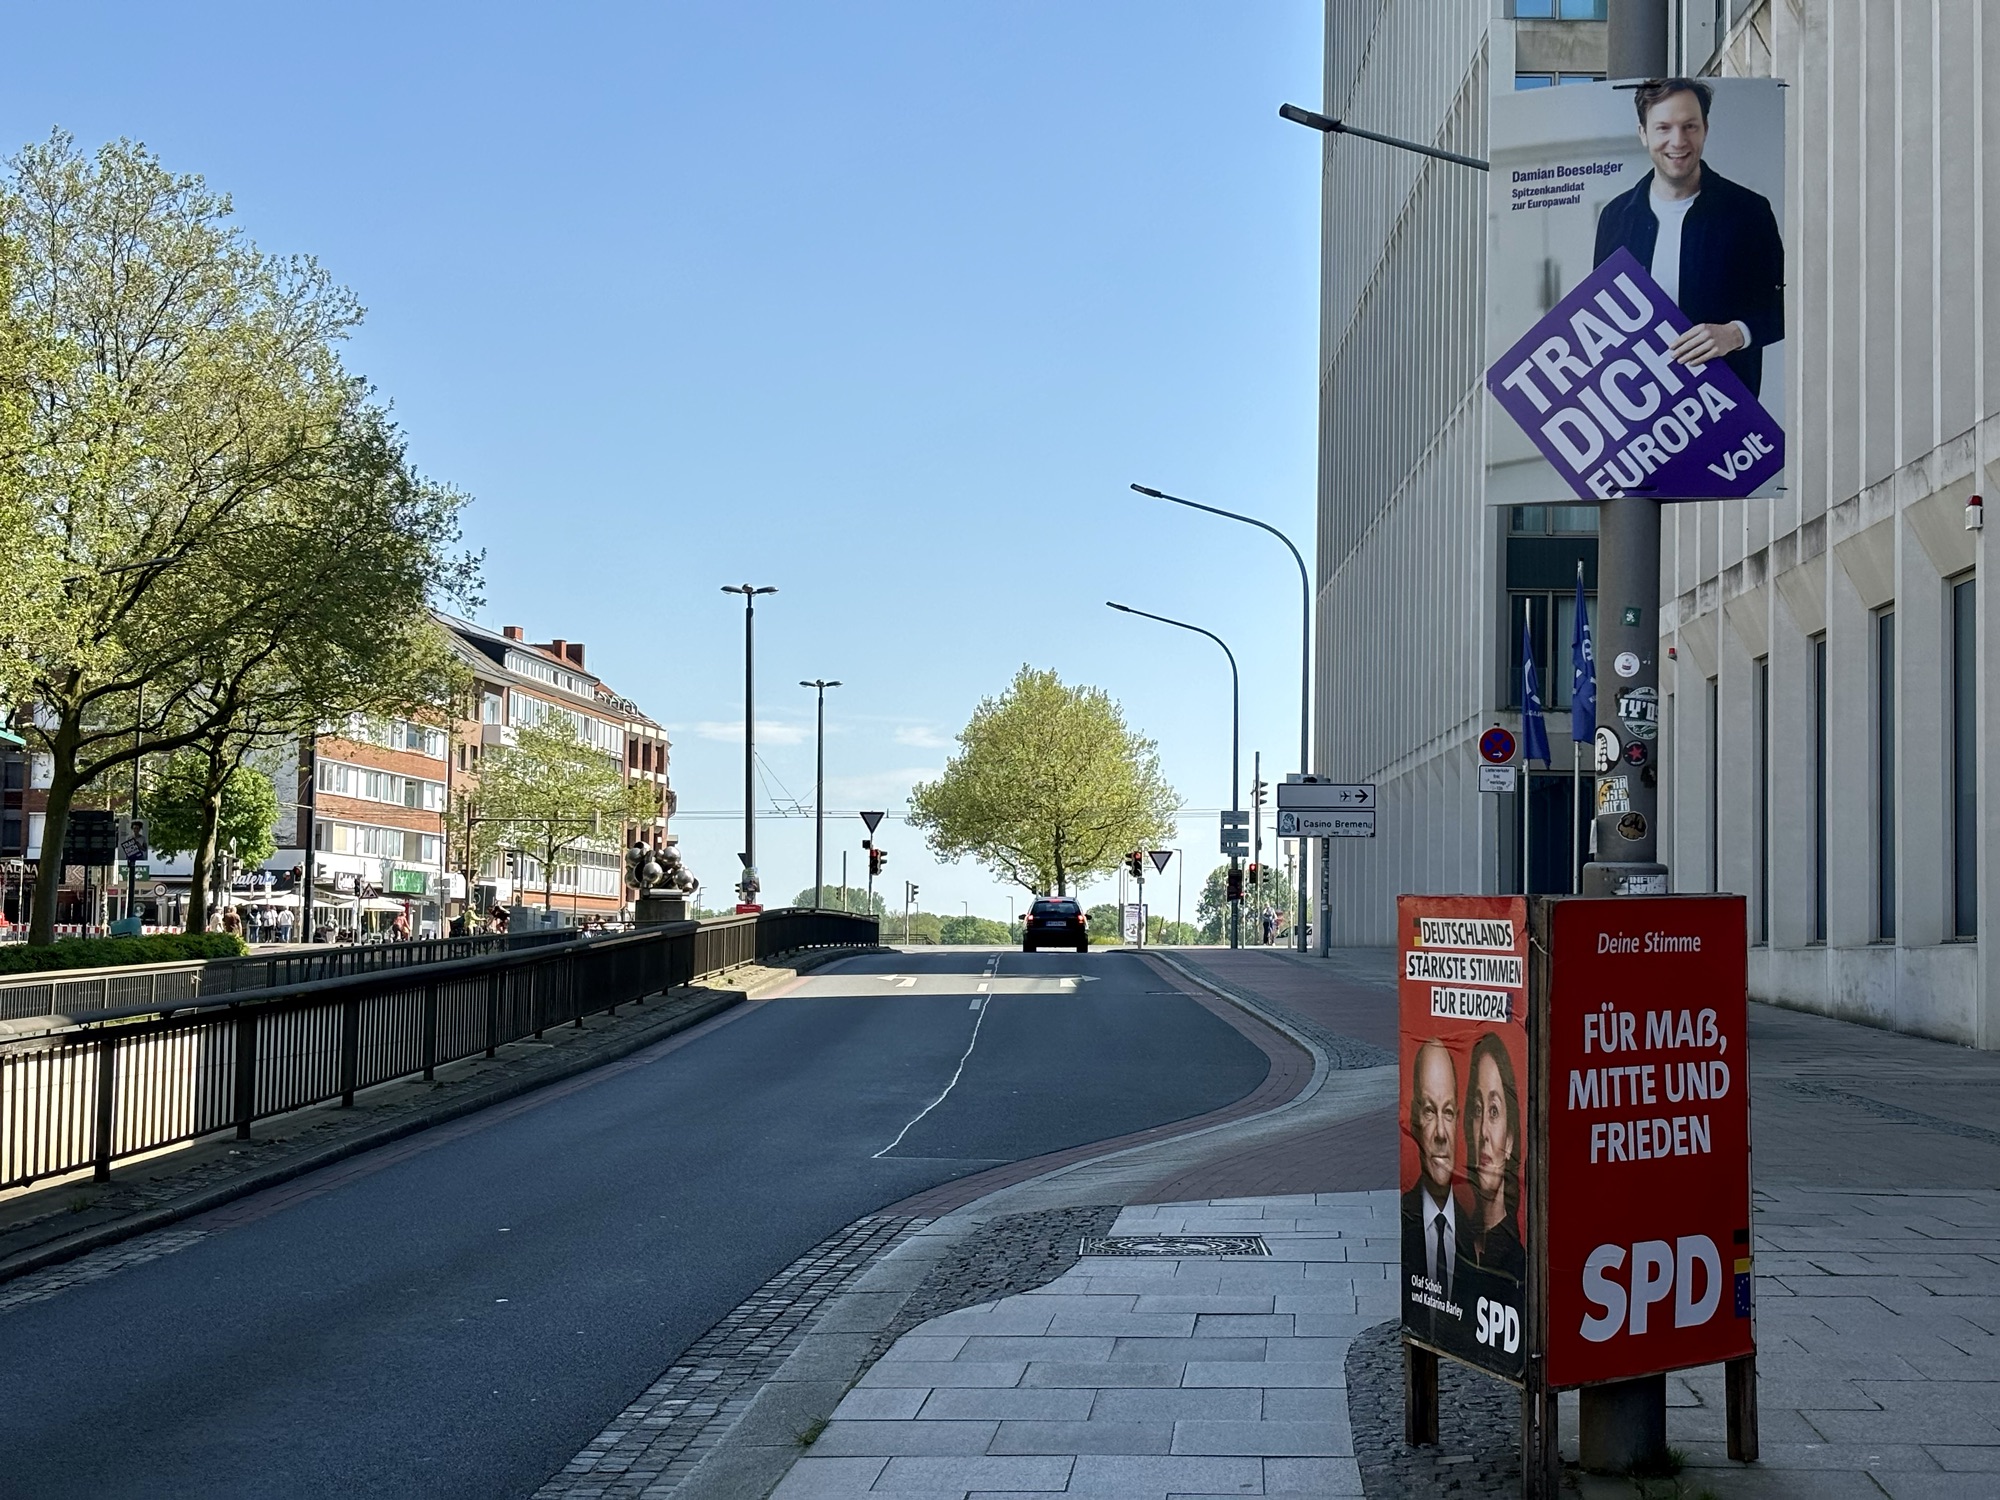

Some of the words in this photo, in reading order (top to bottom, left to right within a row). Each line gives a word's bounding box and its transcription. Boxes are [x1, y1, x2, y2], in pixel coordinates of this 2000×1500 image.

[1512, 167, 1555, 183] Damian
[1556, 161, 1624, 178] Boeselager
[1511, 181, 1585, 199] Spitzenkandidat
[1511, 201, 1527, 211] zur
[1527, 195, 1581, 210] Europawahl
[1501, 271, 1654, 414] TRAU
[1540, 320, 1708, 475] DICH
[1585, 381, 1738, 499] EUROPA
[1707, 432, 1775, 482] Volt
[1303, 819, 1332, 828] Casino
[1335, 819, 1368, 828] Bremen
[1422, 921, 1512, 947] DEUTSCHLANDS
[1597, 931, 1640, 954] Deine
[1643, 930, 1701, 953] Stimme
[1408, 951, 1467, 980] STÄRKSTE
[1469, 957, 1521, 984] STIMMEN
[1433, 986, 1456, 1015] FÜR
[1459, 992, 1505, 1019] EUROPA
[1584, 1001, 1638, 1054] FÜR
[1645, 1008, 1727, 1055] MAß,
[1568, 1065, 1657, 1111] MITTE
[1664, 1060, 1730, 1103] UND
[1590, 1114, 1712, 1164] FRIEDEN
[1411, 1274, 1425, 1288] Olaf
[1424, 1278, 1442, 1295] Scholz
[1579, 1234, 1723, 1343] SPD
[1411, 1291, 1423, 1304] und
[1423, 1294, 1445, 1312] Katarina
[1446, 1300, 1463, 1321] Barley
[1475, 1296, 1520, 1354] SPD
